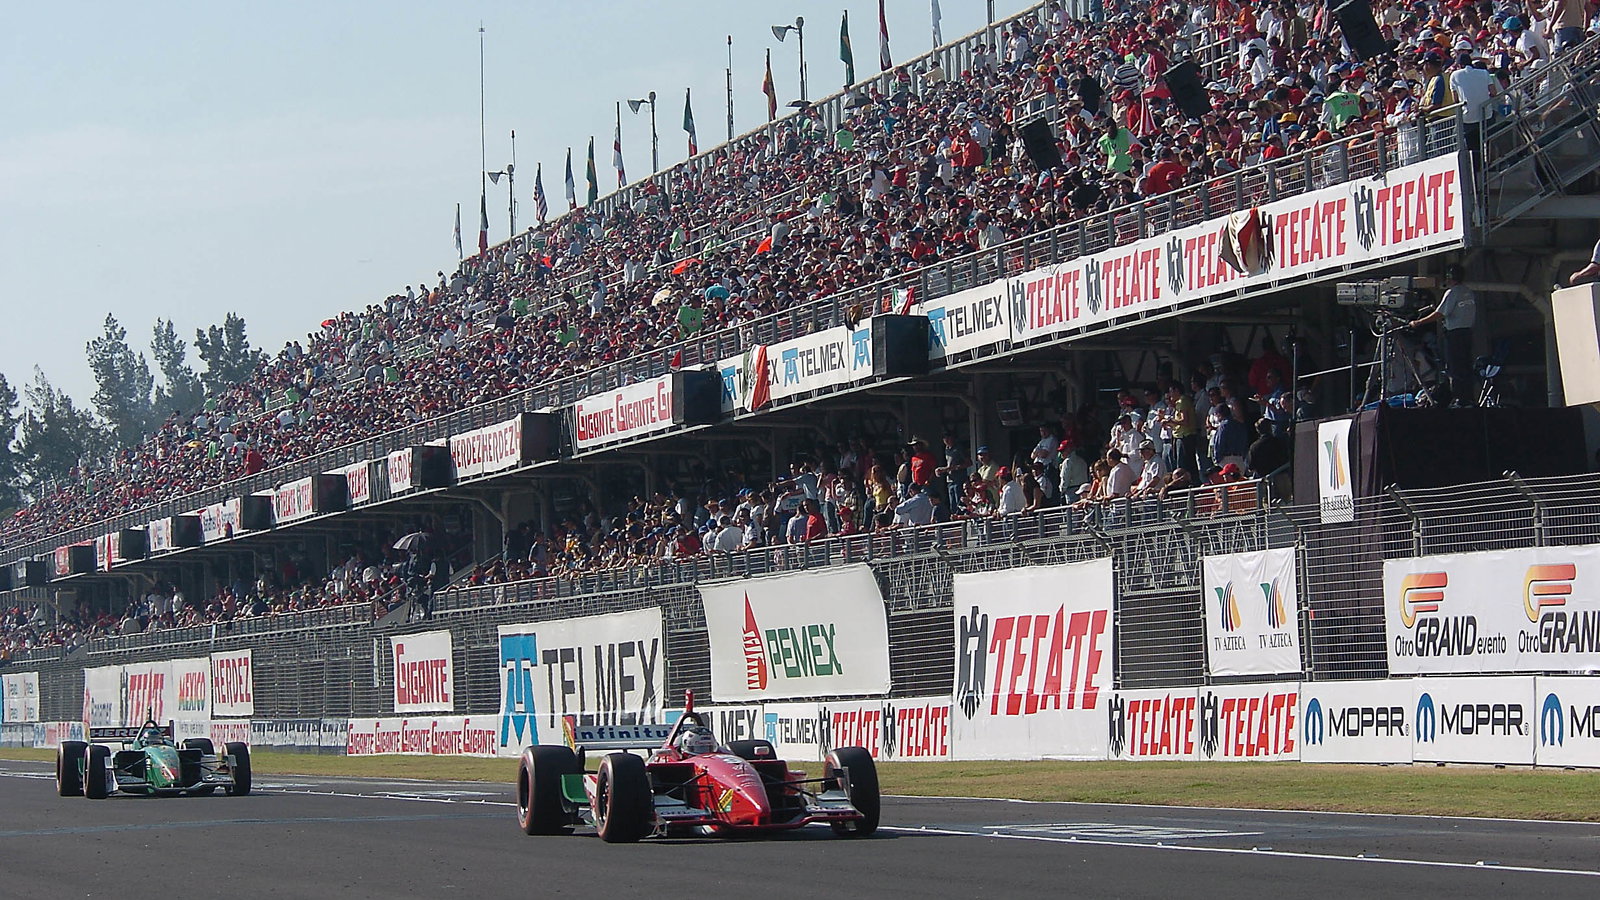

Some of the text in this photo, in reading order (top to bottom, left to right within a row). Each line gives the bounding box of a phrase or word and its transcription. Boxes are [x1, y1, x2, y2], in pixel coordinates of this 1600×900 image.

[1376, 170, 1455, 246] TECATE
[1275, 198, 1346, 268] TECATE
[1101, 247, 1160, 311] TECATE
[1184, 225, 1246, 291] TECA
[947, 295, 1003, 339] TELMEX
[1026, 268, 1080, 330] TECATE
[799, 341, 845, 378] TELMEX
[577, 405, 614, 440] GIGANTE
[616, 394, 656, 431] GIGANTE
[389, 452, 412, 483] HERDE
[452, 435, 481, 469] HERDEZ
[482, 425, 515, 463] HERDEZ
[765, 623, 843, 679] PEMEX
[1214, 636, 1246, 651] TV AZTECA
[1259, 633, 1292, 648] TV AZTECA
[1395, 616, 1507, 656] Otro GRAND evento
[1518, 611, 1600, 653] Otro GRAN
[396, 643, 449, 704] GIGANTE
[989, 603, 1107, 716] TECATE
[214, 657, 251, 708] HERDEZ
[542, 638, 659, 729] TELMEX
[348, 723, 373, 754] GIGANTE
[375, 722, 400, 753] GIGANTE
[402, 720, 430, 752] GIGANTE
[432, 721, 461, 754] GIGANTE
[464, 719, 495, 754] GIGANTE
[573, 727, 673, 740] infinitu
[779, 718, 818, 744] TELMEX
[832, 707, 880, 758] TECATE
[897, 703, 948, 757] TECATE
[1127, 693, 1196, 756] TECATE
[1220, 692, 1297, 757] TECATE
[1329, 707, 1405, 737] MOPAR
[1441, 704, 1523, 735] MOPAR
